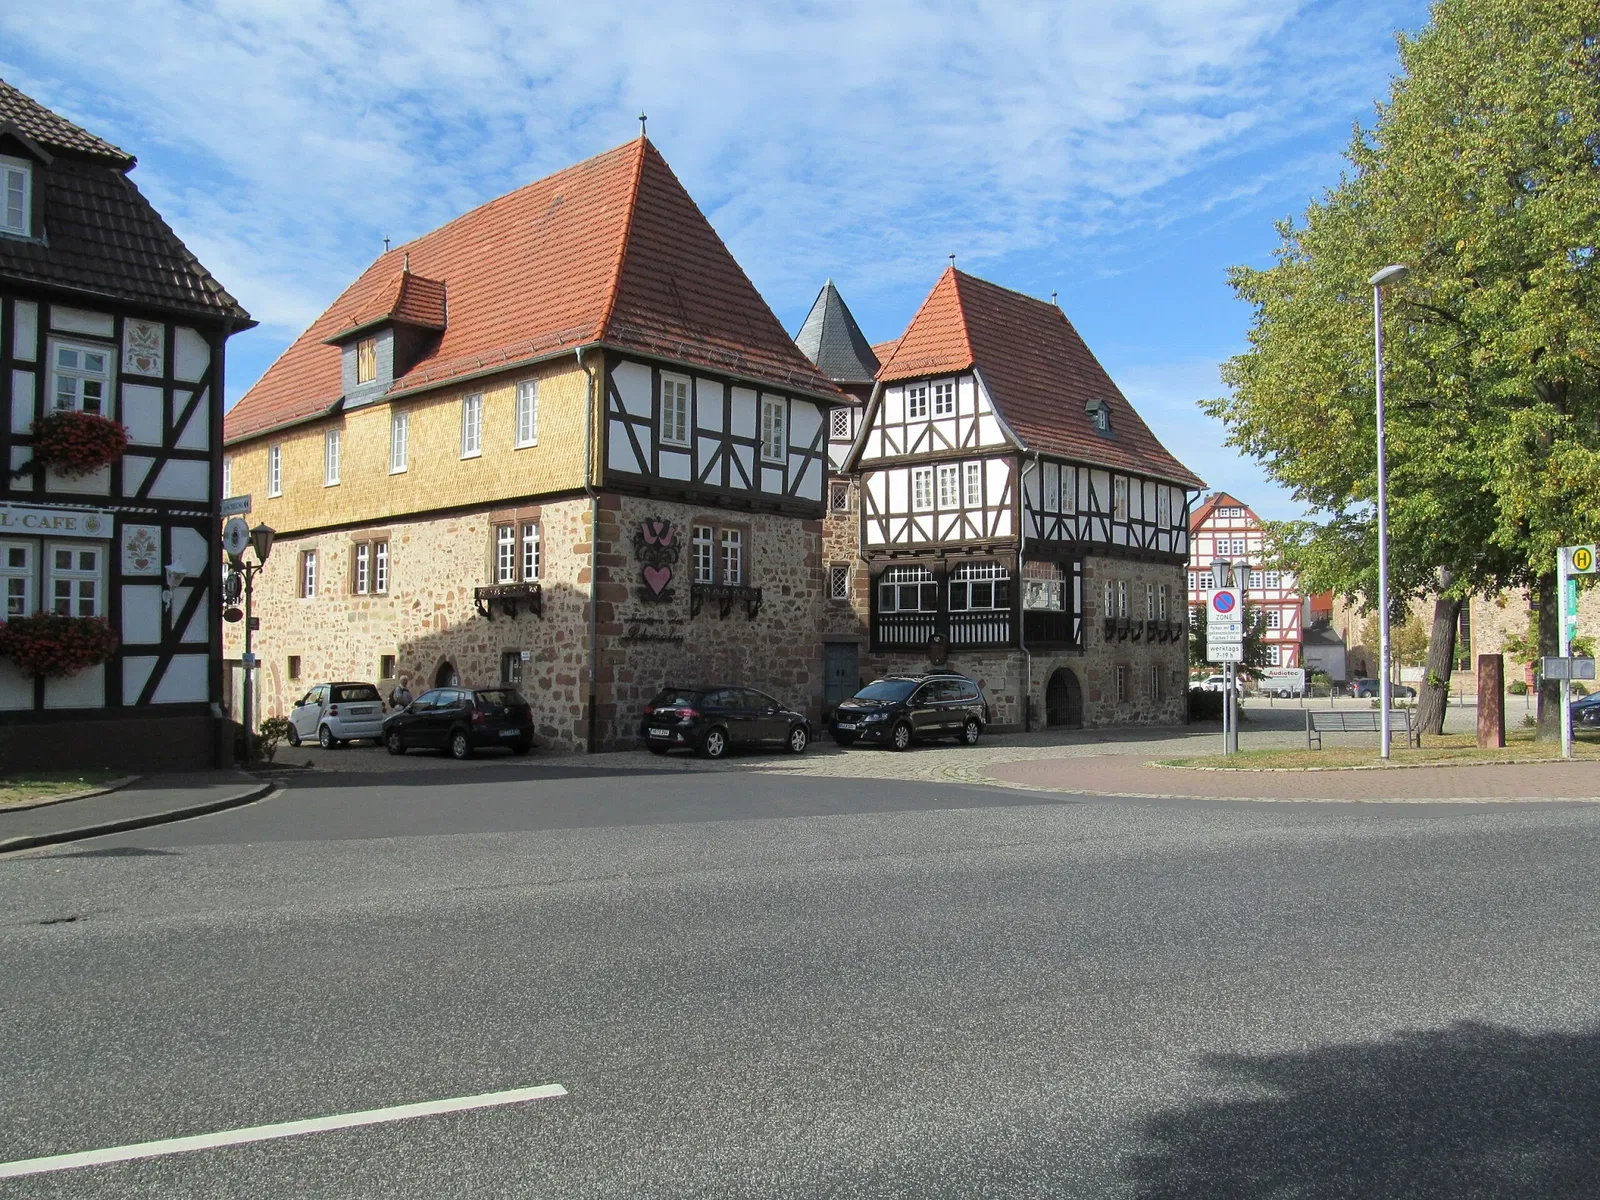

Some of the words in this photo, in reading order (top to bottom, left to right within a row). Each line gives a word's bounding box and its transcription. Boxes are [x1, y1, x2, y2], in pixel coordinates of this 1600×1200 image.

[23, 515, 76, 530] CAFE
[1577, 552, 1587, 567] H
[1210, 645, 1240, 653] werktags
